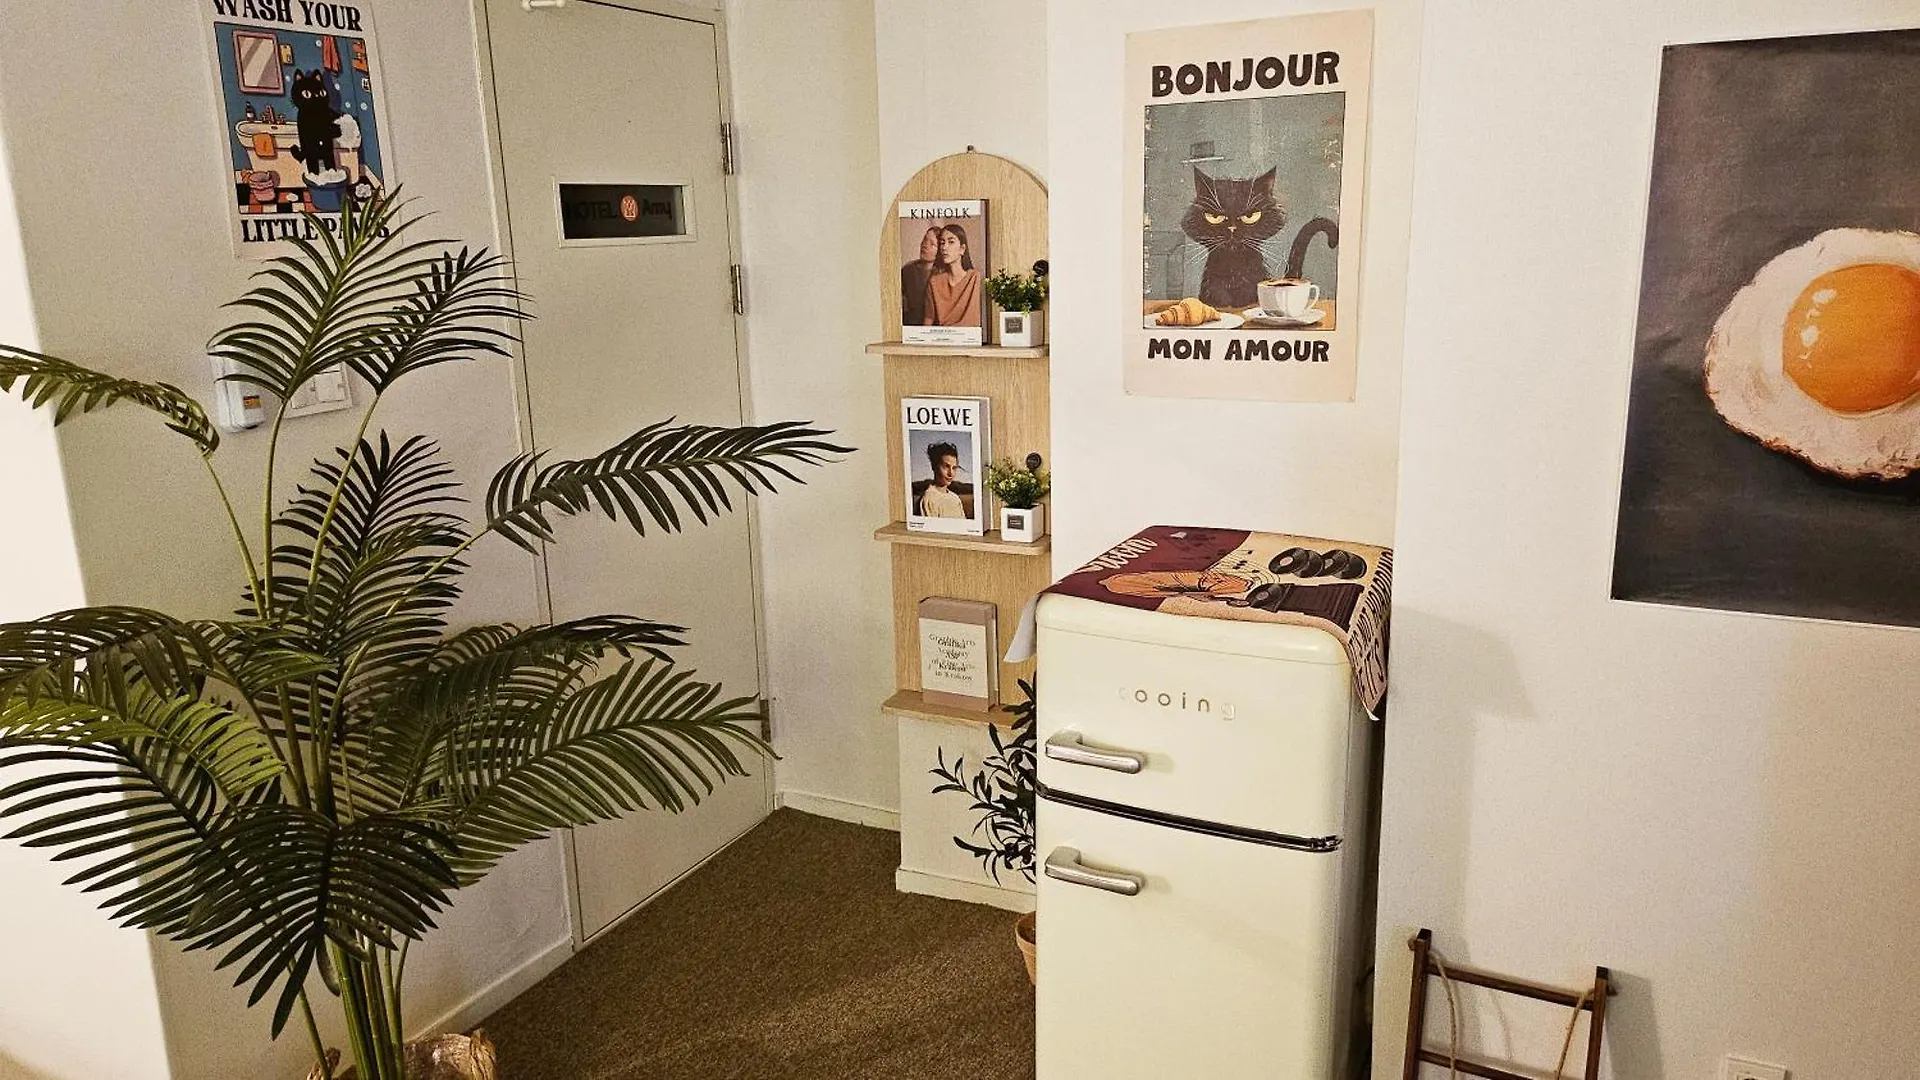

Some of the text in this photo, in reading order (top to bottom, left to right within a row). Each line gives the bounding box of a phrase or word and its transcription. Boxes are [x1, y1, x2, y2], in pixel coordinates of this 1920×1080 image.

[213, 0, 363, 32] WASH YOUR
[1151, 50, 1341, 98] BONJOUR
[910, 206, 971, 219] KINFOLK
[240, 217, 390, 243] LITTLE PAS
[1146, 337, 1330, 362] MON AMOUR
[906, 406, 973, 426] LOEWE
